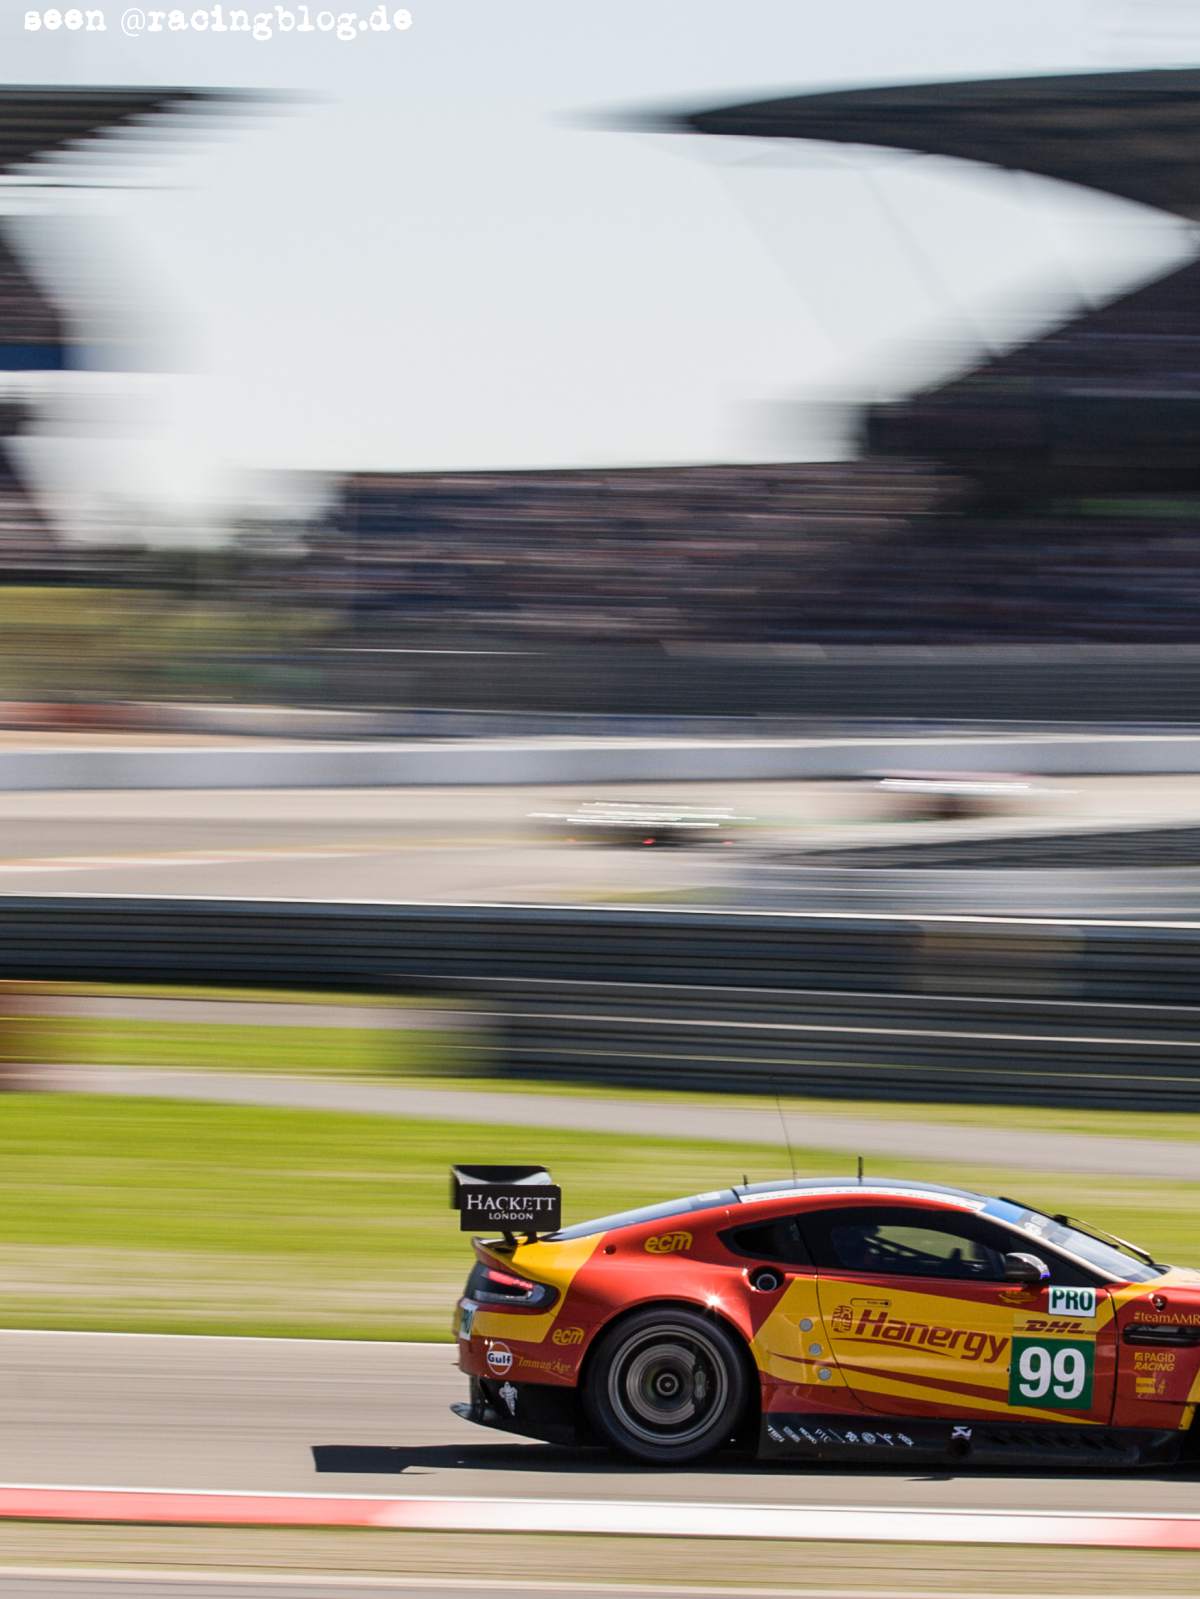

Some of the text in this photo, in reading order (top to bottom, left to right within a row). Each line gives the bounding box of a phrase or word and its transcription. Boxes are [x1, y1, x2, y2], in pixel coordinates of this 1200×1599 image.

[466, 1194, 556, 1211] HACKETT
[488, 1212, 534, 1221] LONDON
[644, 1231, 693, 1254] ecm
[1051, 1288, 1094, 1311] PRO
[1024, 1319, 1085, 1334] DHL
[1133, 1312, 1200, 1325] #teamAMR
[552, 1327, 585, 1346] ecm
[855, 1308, 1010, 1363] Hanergy
[487, 1352, 512, 1365] Gulf
[1144, 1352, 1176, 1363] PAGID
[1018, 1345, 1087, 1400] 99
[1134, 1361, 1176, 1371] RACING
